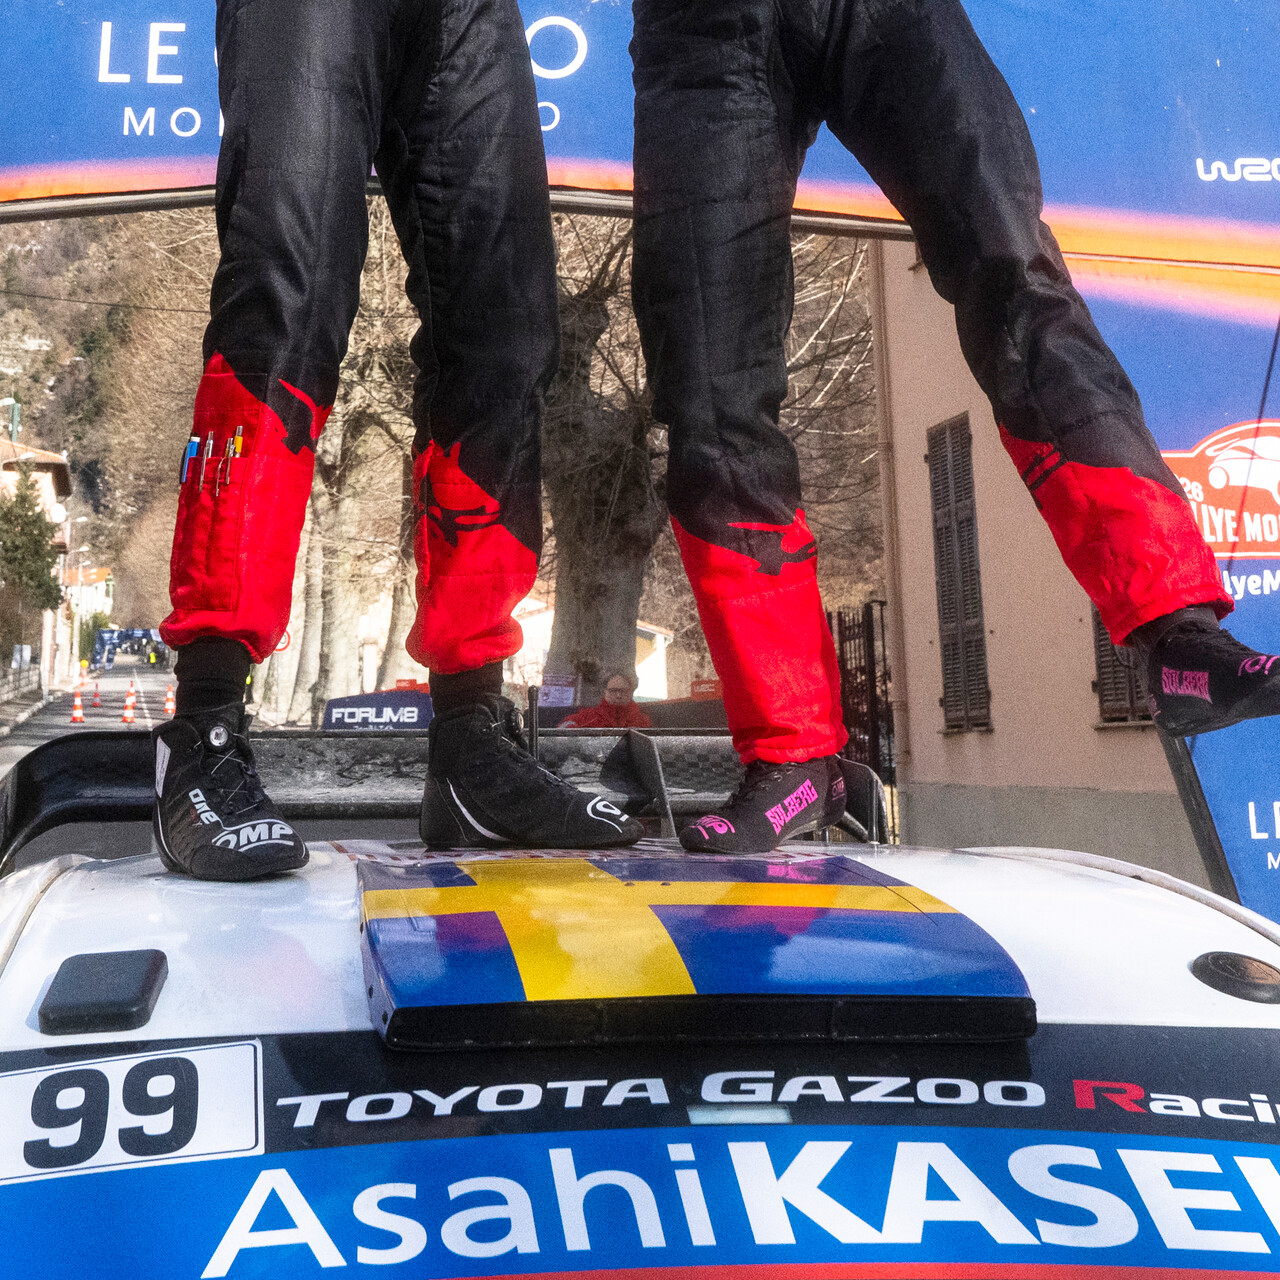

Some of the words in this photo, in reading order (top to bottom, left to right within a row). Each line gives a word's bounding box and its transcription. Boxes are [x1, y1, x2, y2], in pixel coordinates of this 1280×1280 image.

[98, 21, 186, 83] LE
[331, 707, 419, 723] FORUM8
[214, 822, 294, 850] OMP
[765, 778, 819, 836] SOLBERG
[23, 1057, 200, 1169] 99
[276, 1078, 671, 1128] TOYOTA
[700, 1070, 1047, 1106] GAZOO
